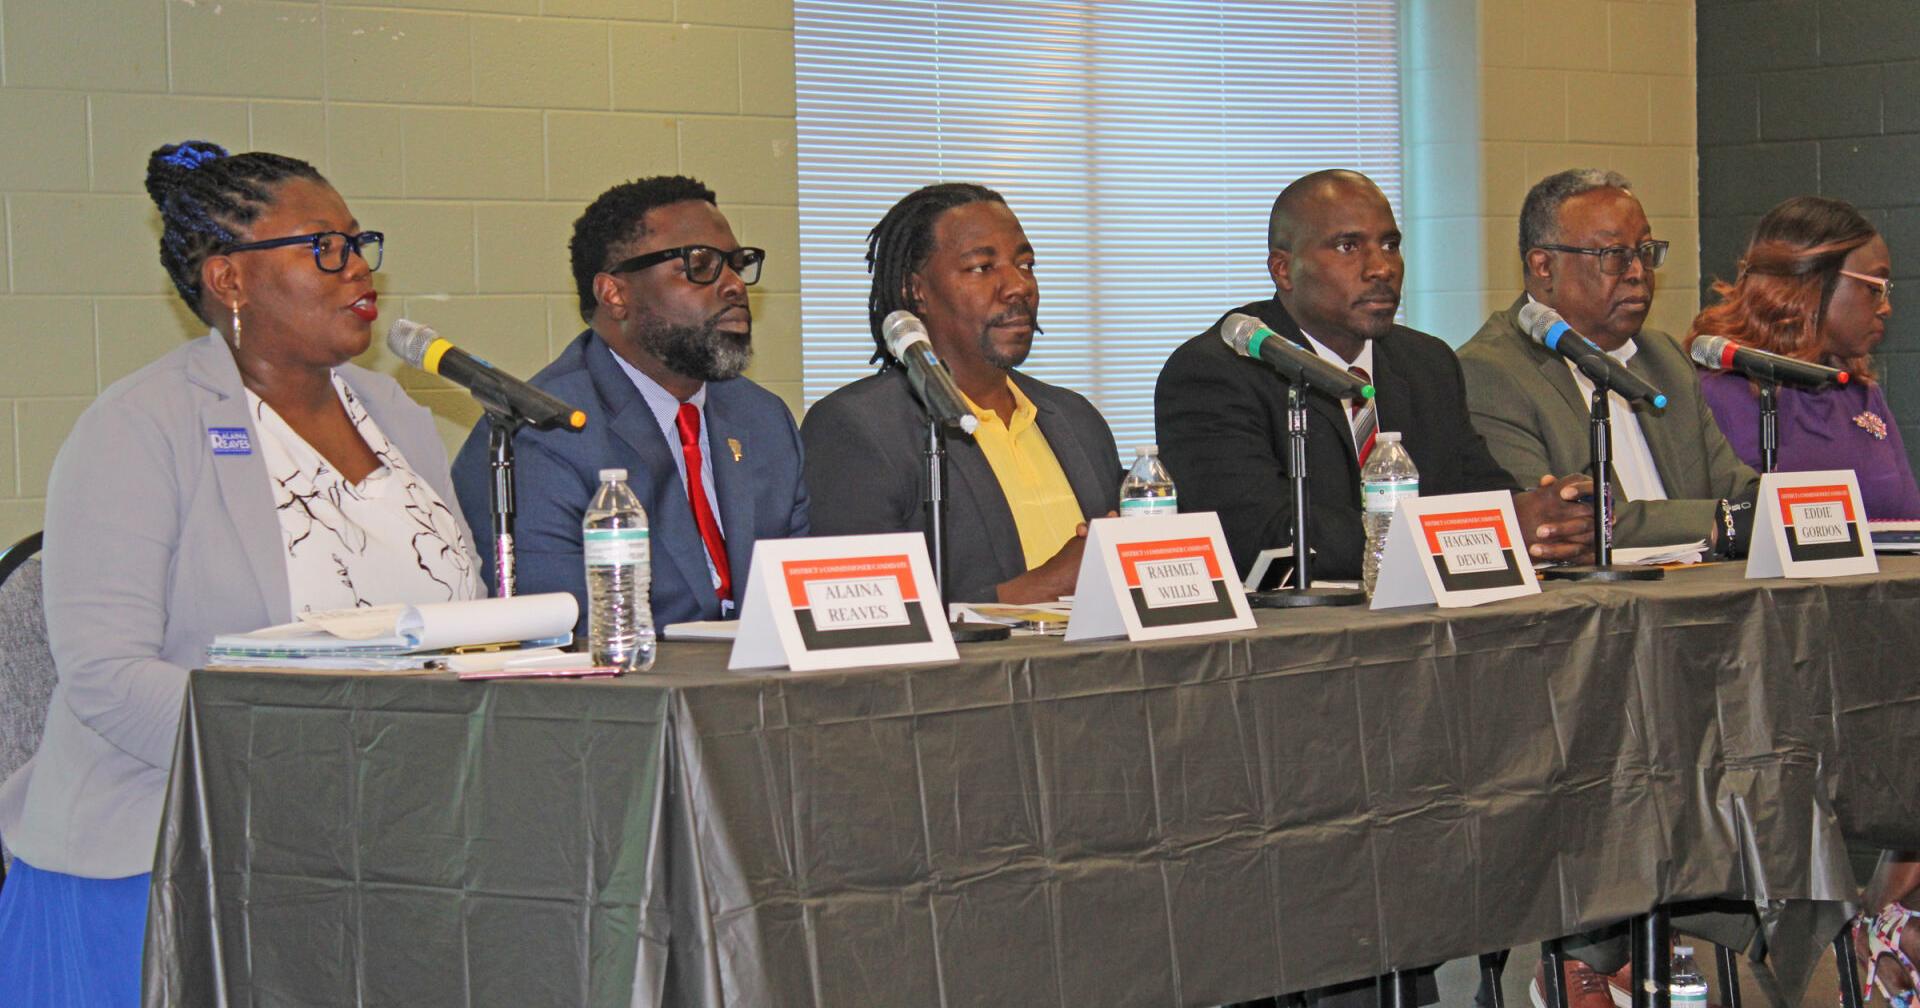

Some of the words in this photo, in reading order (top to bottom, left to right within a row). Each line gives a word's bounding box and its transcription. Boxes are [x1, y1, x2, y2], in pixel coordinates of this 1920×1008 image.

[210, 433, 250, 448] REAVES
[1804, 507, 1832, 519] EDDIE
[1802, 525, 1841, 538] GORDON
[1443, 532, 1493, 549] HACKWIN
[1456, 552, 1492, 567] DEVOE
[1147, 562, 1199, 580] RAHMEL
[826, 583, 884, 600] ALAINA
[1159, 584, 1200, 600] WILLIS
[829, 604, 889, 622] REAVES
